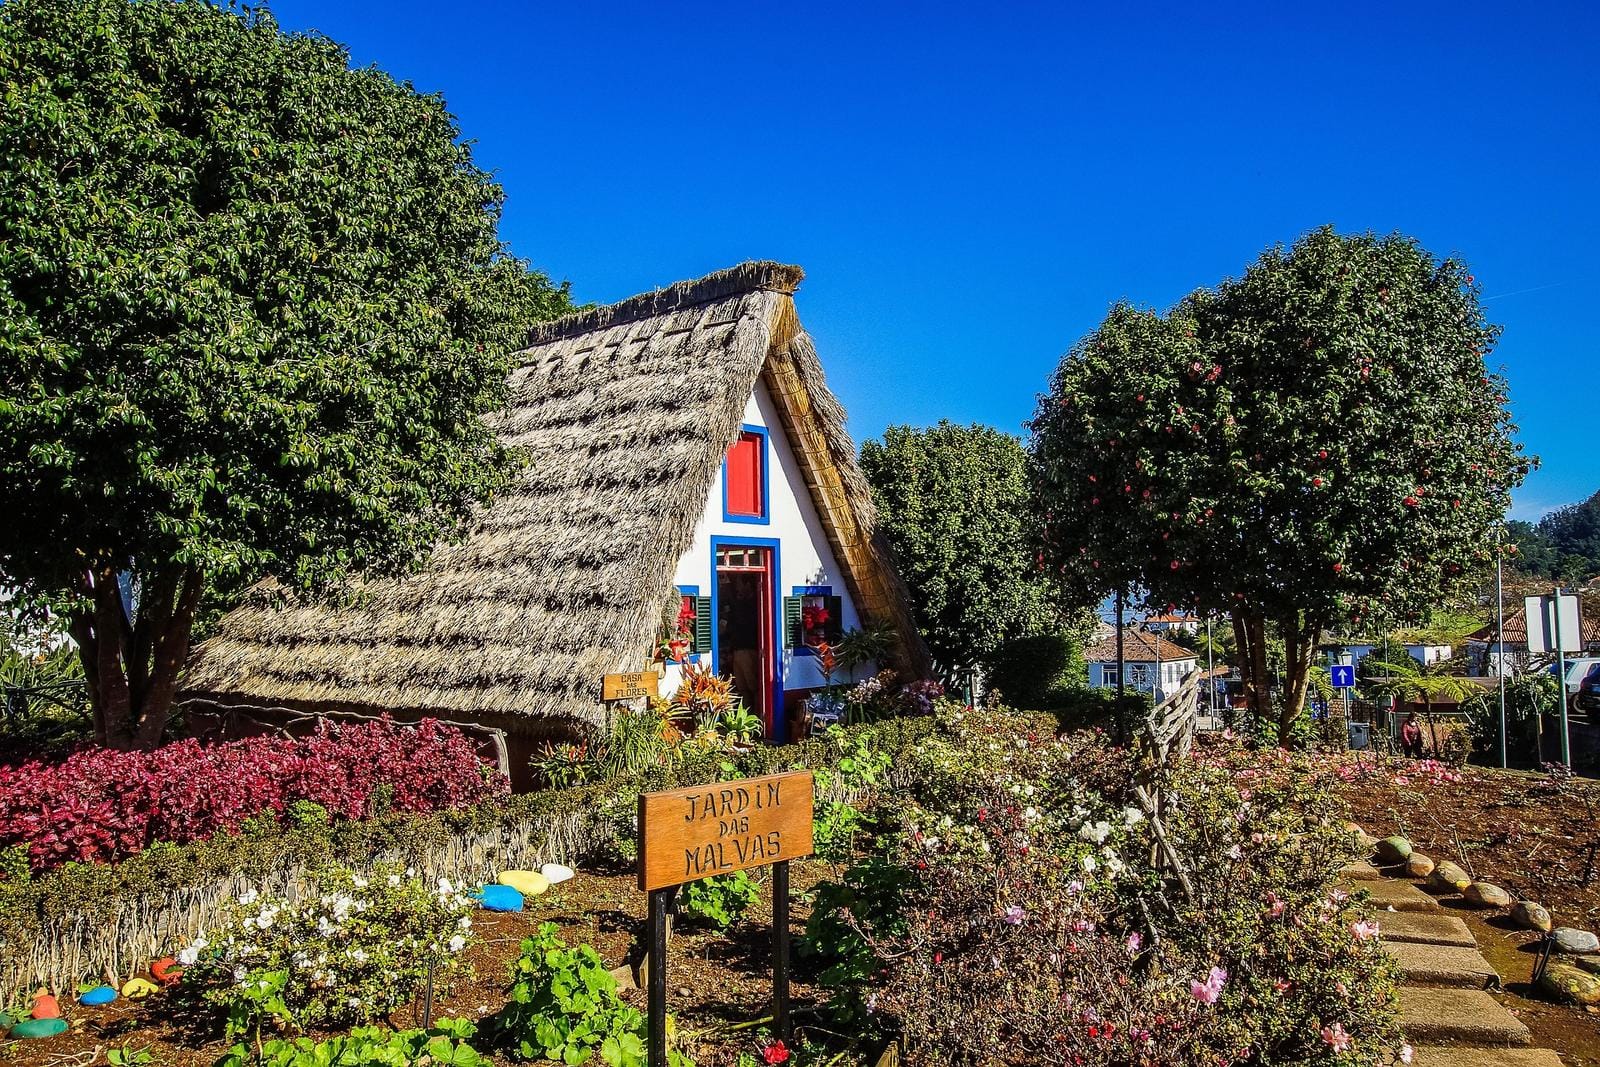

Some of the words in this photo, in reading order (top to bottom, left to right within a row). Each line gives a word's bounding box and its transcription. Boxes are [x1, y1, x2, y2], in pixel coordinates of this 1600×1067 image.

[621, 674, 642, 683] CASA
[615, 687, 648, 698] FLORES
[719, 816, 749, 838] DAS
[685, 831, 781, 876] MALVAS
